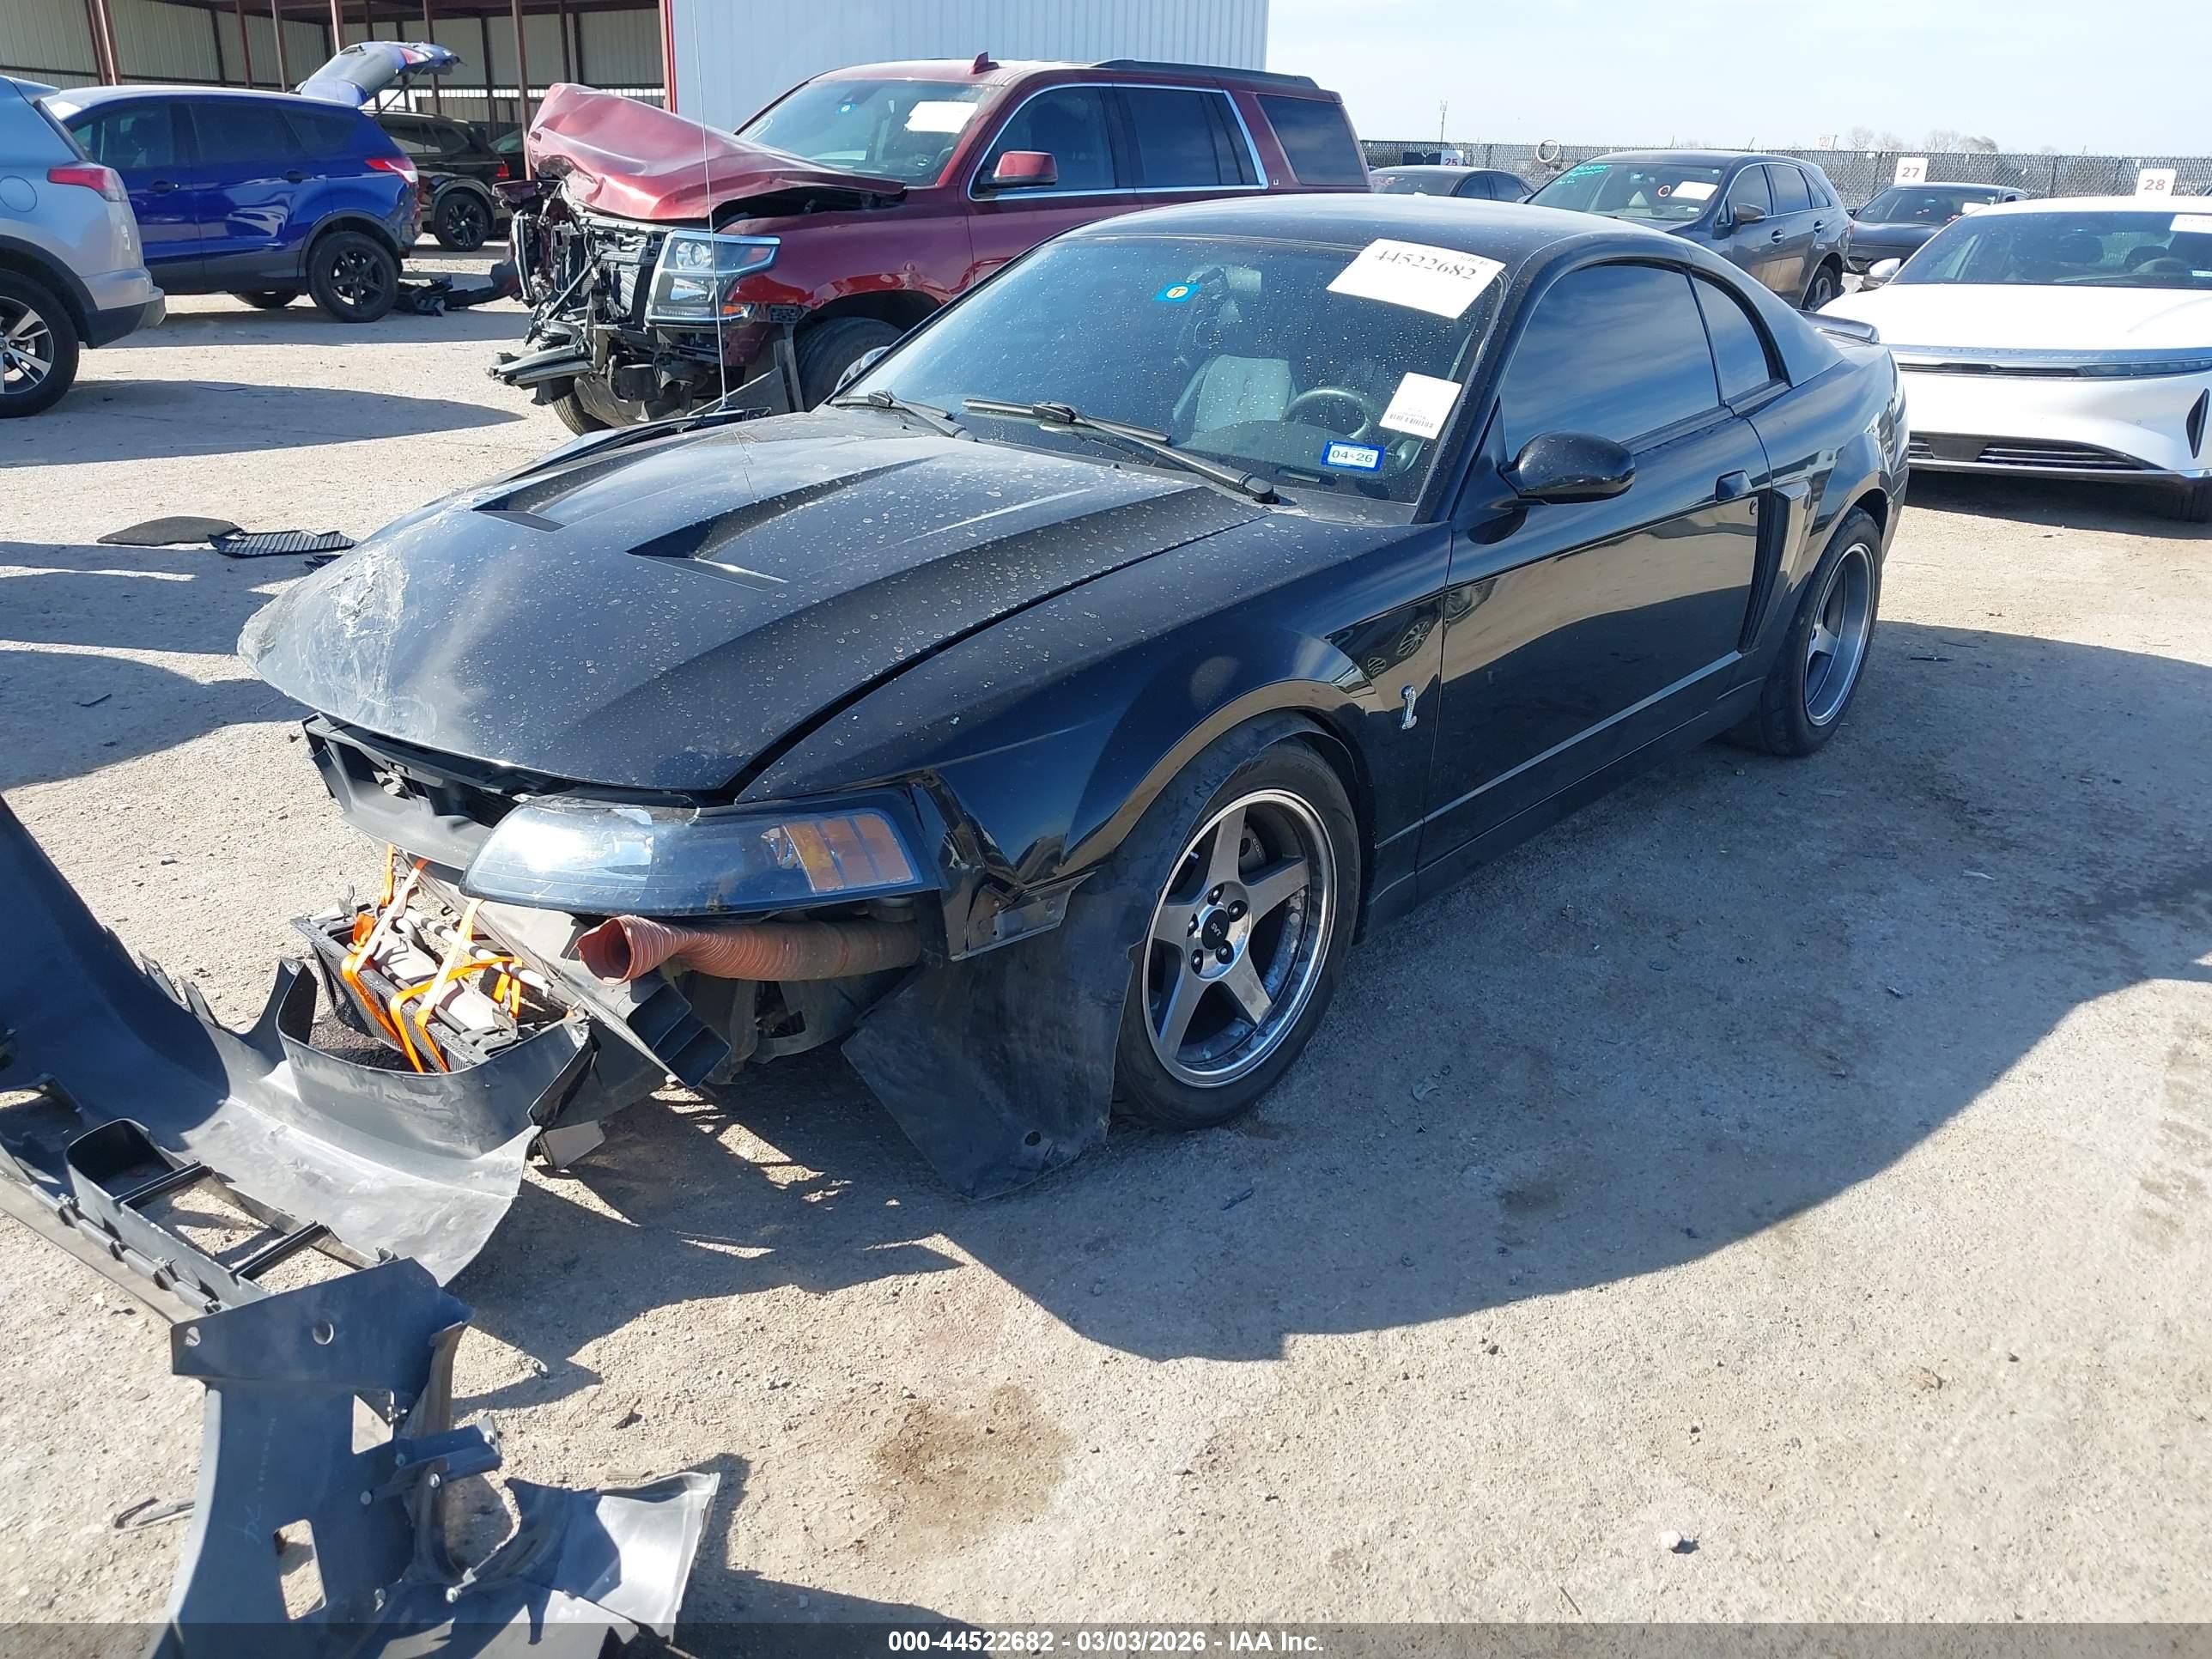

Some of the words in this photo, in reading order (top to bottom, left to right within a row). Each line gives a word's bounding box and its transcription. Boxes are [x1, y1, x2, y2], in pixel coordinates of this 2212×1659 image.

[1444, 157, 1458, 166] 25
[1901, 167, 1920, 178] 27
[2143, 179, 2166, 191] 28
[1375, 250, 1477, 280] 44522682
[1211, 922, 1222, 937] SVT
